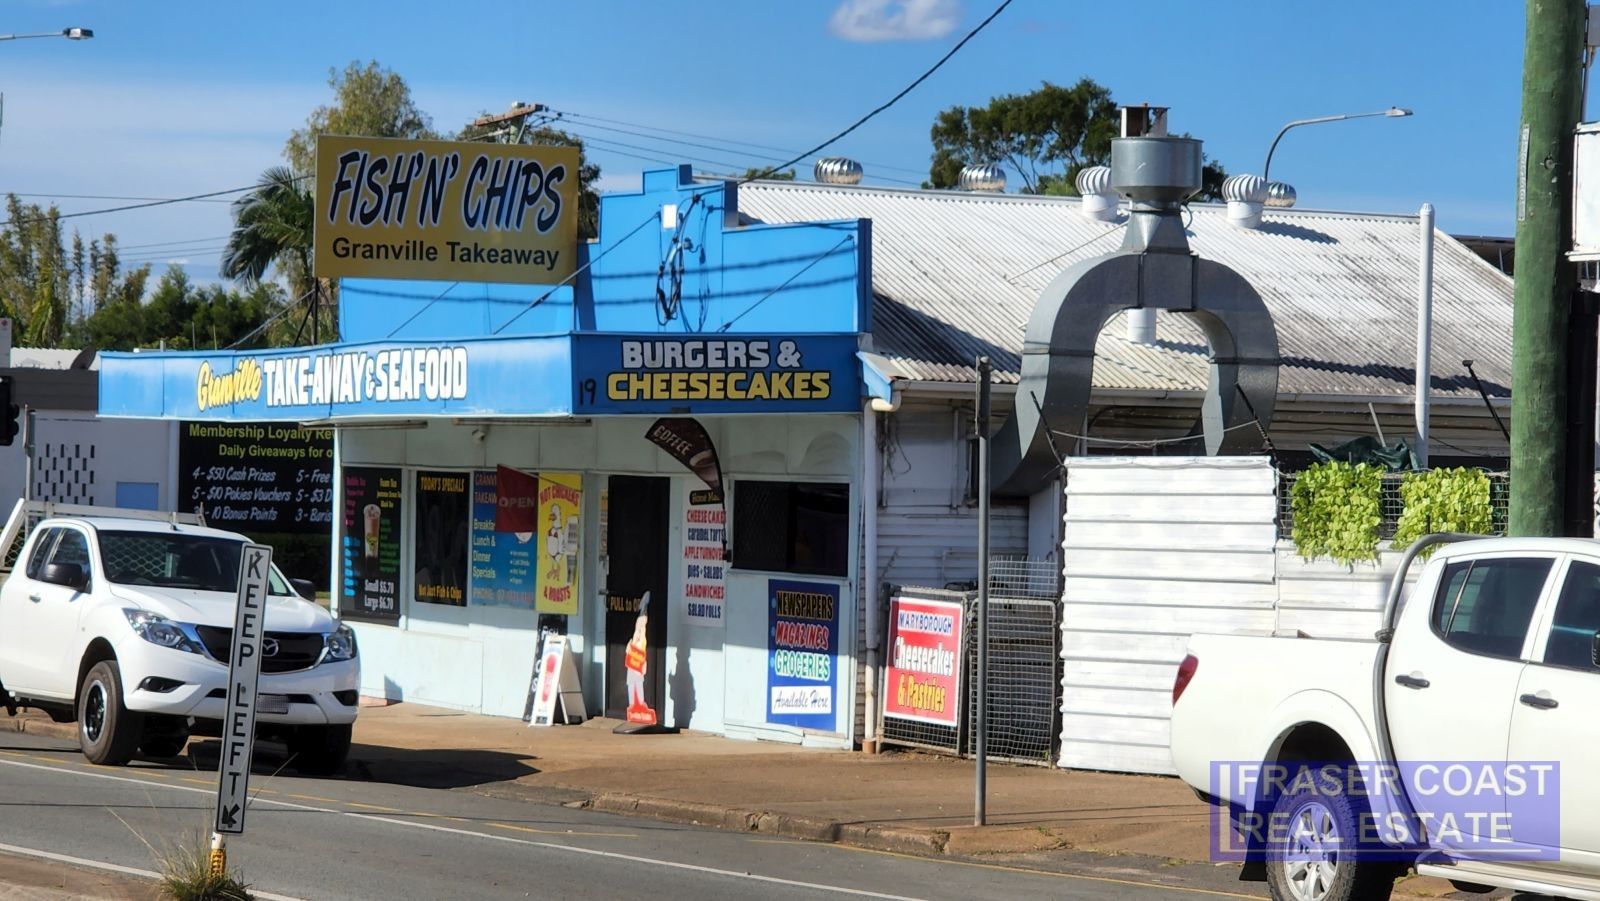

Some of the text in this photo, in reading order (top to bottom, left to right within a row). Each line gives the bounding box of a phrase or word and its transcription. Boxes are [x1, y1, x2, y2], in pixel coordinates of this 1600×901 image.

[463, 155, 566, 233] CHIPS
[333, 237, 559, 271] Granville Takeaway
[622, 340, 801, 369] BURGERS &
[197, 356, 262, 412] Granville
[263, 350, 367, 407] TAKE-AWAY
[375, 346, 468, 402] SEAFOOD
[607, 372, 831, 400] CHEESECAKES
[579, 378, 597, 405] 19
[189, 423, 334, 442] Membership Loyalty Re
[653, 425, 693, 456] COFFEE
[219, 444, 246, 459] Daily
[249, 445, 306, 460] Giveaways
[308, 446, 324, 458] for
[207, 466, 225, 481] $50
[226, 466, 247, 481] Cash
[248, 467, 277, 482] Prizes
[311, 469, 331, 483] Free
[207, 486, 224, 501] $10
[224, 487, 253, 501] Pokies
[254, 487, 292, 502] Vouchers
[442, 477, 465, 493] SPECIALS
[325, 488, 333, 502] D
[499, 496, 535, 508] OPEN
[222, 506, 249, 520] Bonus
[250, 507, 279, 521] Points
[310, 508, 333, 522] Baris
[687, 510, 707, 523] CHEESE
[474, 517, 496, 530] Breakfa
[473, 535, 490, 547] Lunch
[473, 551, 492, 562] Dinner
[684, 546, 725, 561] APPLE TURNOVE
[472, 567, 496, 579] Specials
[686, 584, 724, 599] SANDWICHES
[238, 550, 263, 667] KEEP
[610, 595, 641, 613] PULL to OP
[777, 591, 833, 621] NEWSPAPERS
[899, 612, 952, 634] MARYBOROUGH
[775, 621, 830, 650] MAGAZINES
[894, 635, 954, 676] Cheesecakes
[775, 649, 831, 682] GROCERIES
[774, 689, 829, 710] Available Here
[907, 675, 946, 712] Pastries
[228, 683, 249, 797] LEFT
